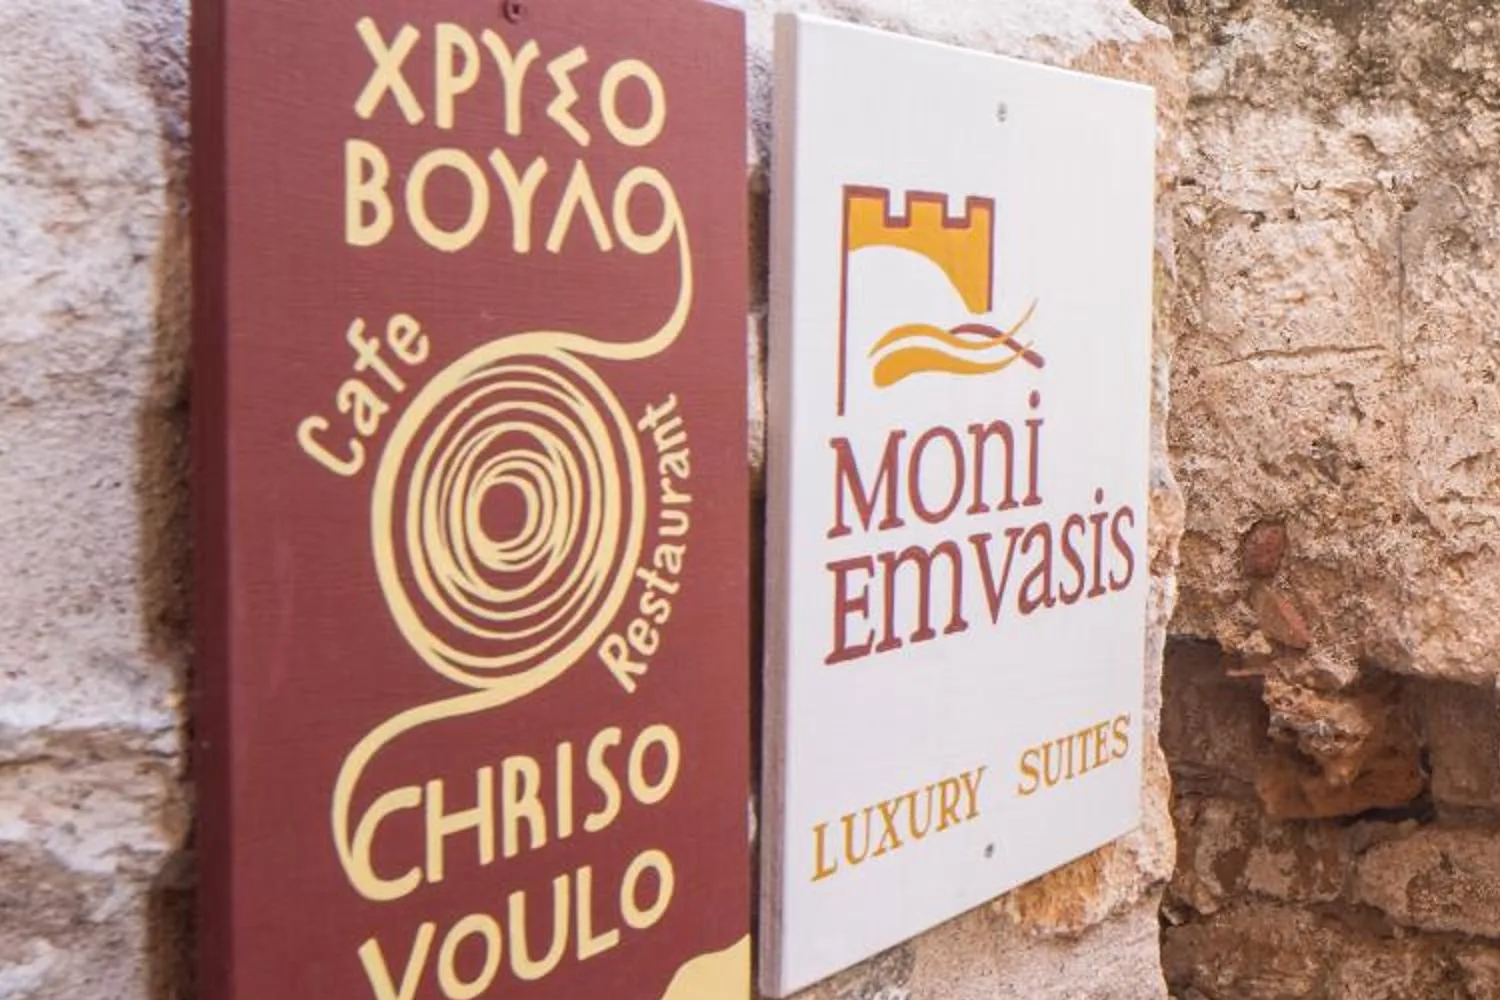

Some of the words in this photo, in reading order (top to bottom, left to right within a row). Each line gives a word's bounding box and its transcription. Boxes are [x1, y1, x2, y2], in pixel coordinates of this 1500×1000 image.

[344, 138, 680, 254] ΒΟΥΛΟ
[296, 312, 431, 477] Cafe
[598, 393, 692, 694] Restaurant
[350, 723, 681, 902] CHRISO
[809, 765, 988, 883] LUXURY
[1016, 712, 1132, 797] SUITES
